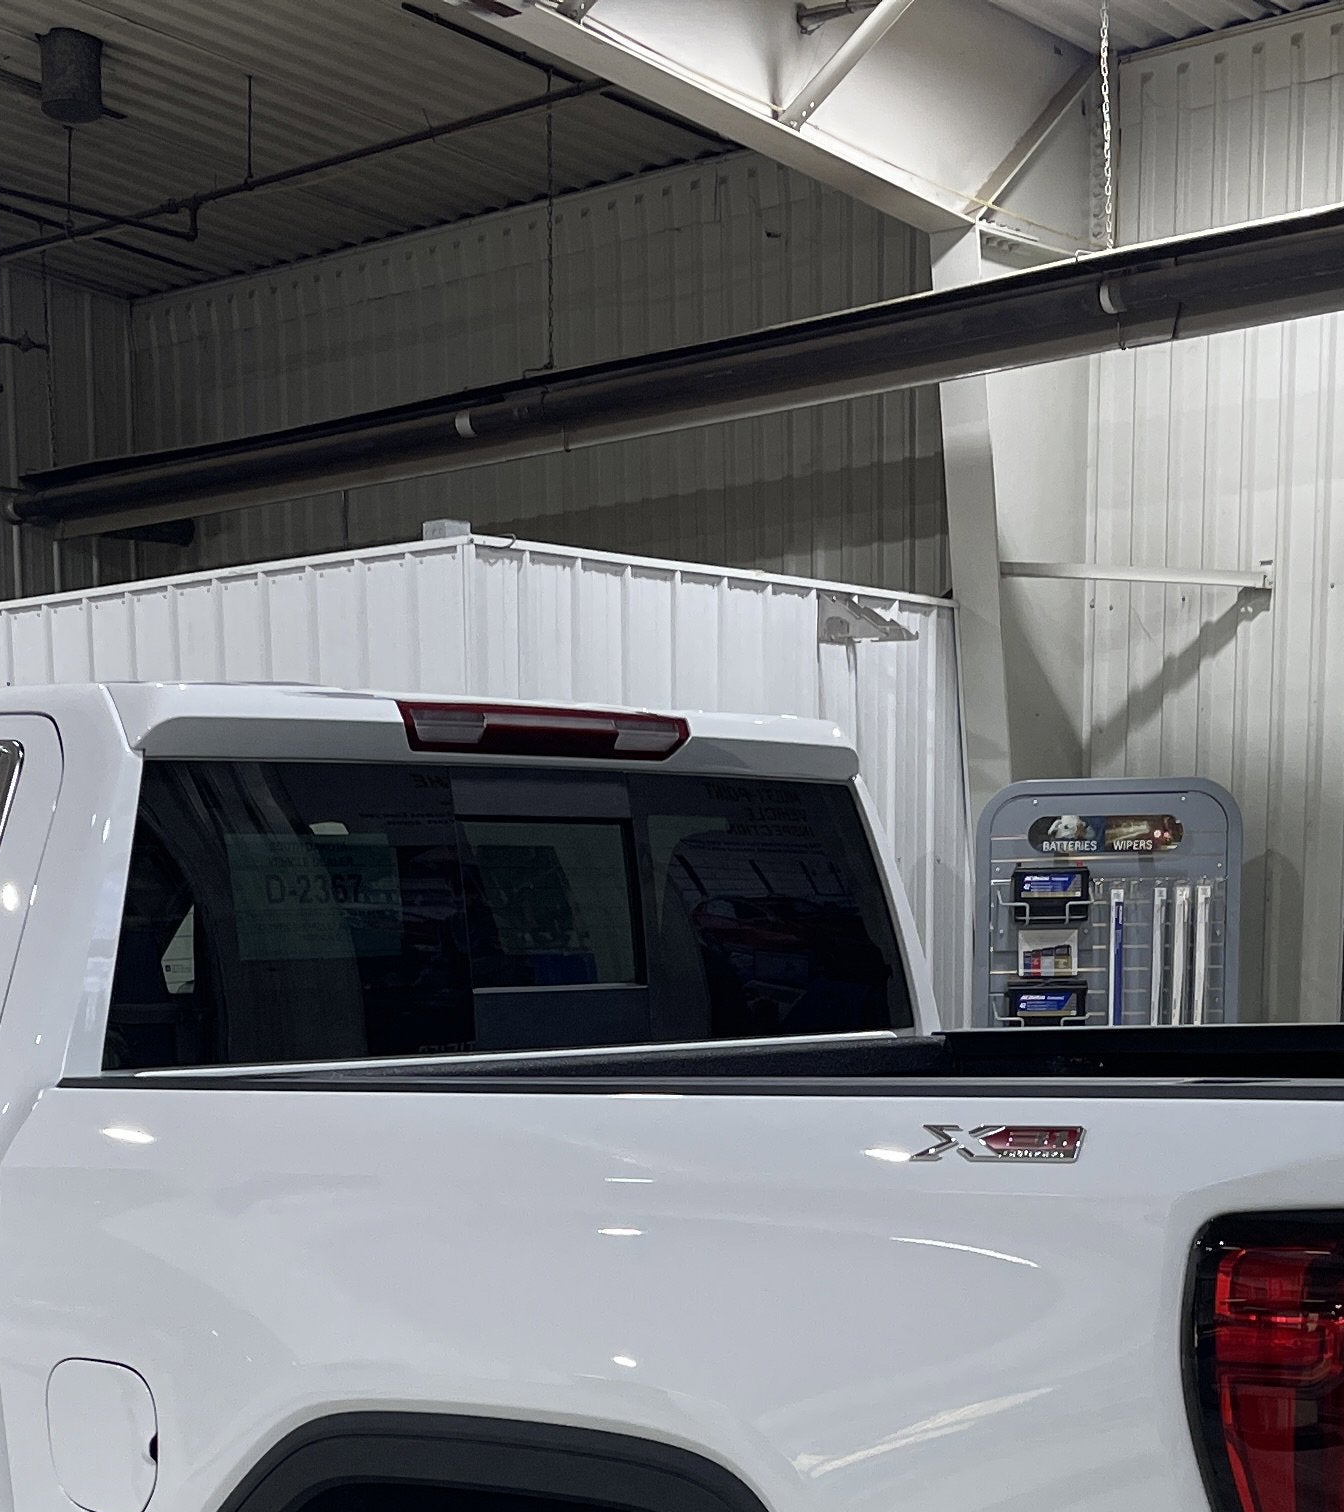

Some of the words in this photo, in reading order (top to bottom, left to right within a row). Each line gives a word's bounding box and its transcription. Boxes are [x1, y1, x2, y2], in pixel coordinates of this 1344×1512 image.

[1042, 840, 1097, 852] BATTERIES
[1113, 839, 1153, 851] WIPERS
[264, 873, 363, 903] D-2367
